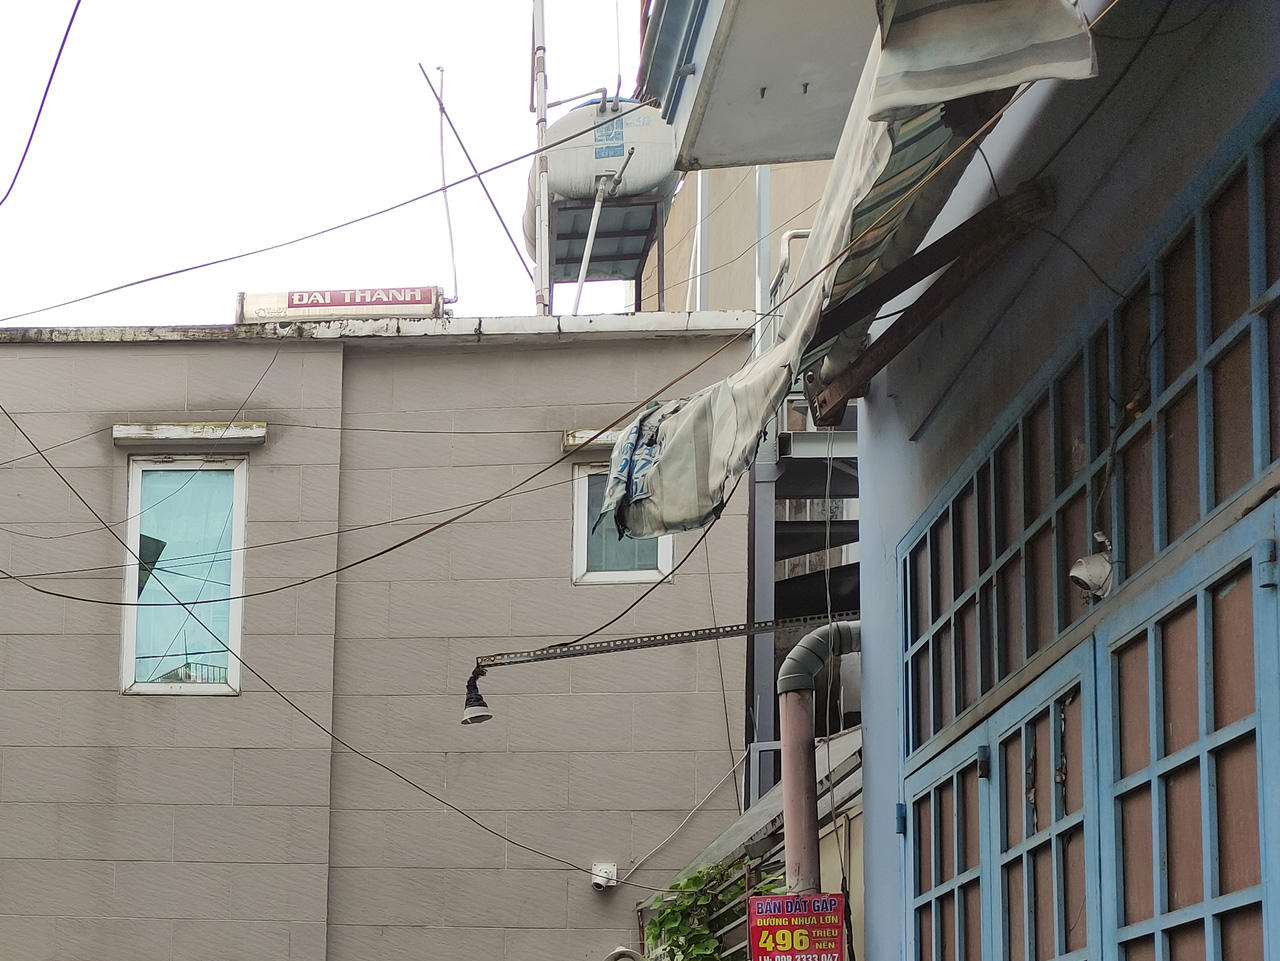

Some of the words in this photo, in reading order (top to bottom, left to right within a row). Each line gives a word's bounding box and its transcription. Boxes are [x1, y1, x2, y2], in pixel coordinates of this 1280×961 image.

[756, 898, 782, 915] BÁN
[785, 894, 808, 913] ĐẤT
[812, 894, 837, 912] GẤP
[758, 929, 810, 951] 496
